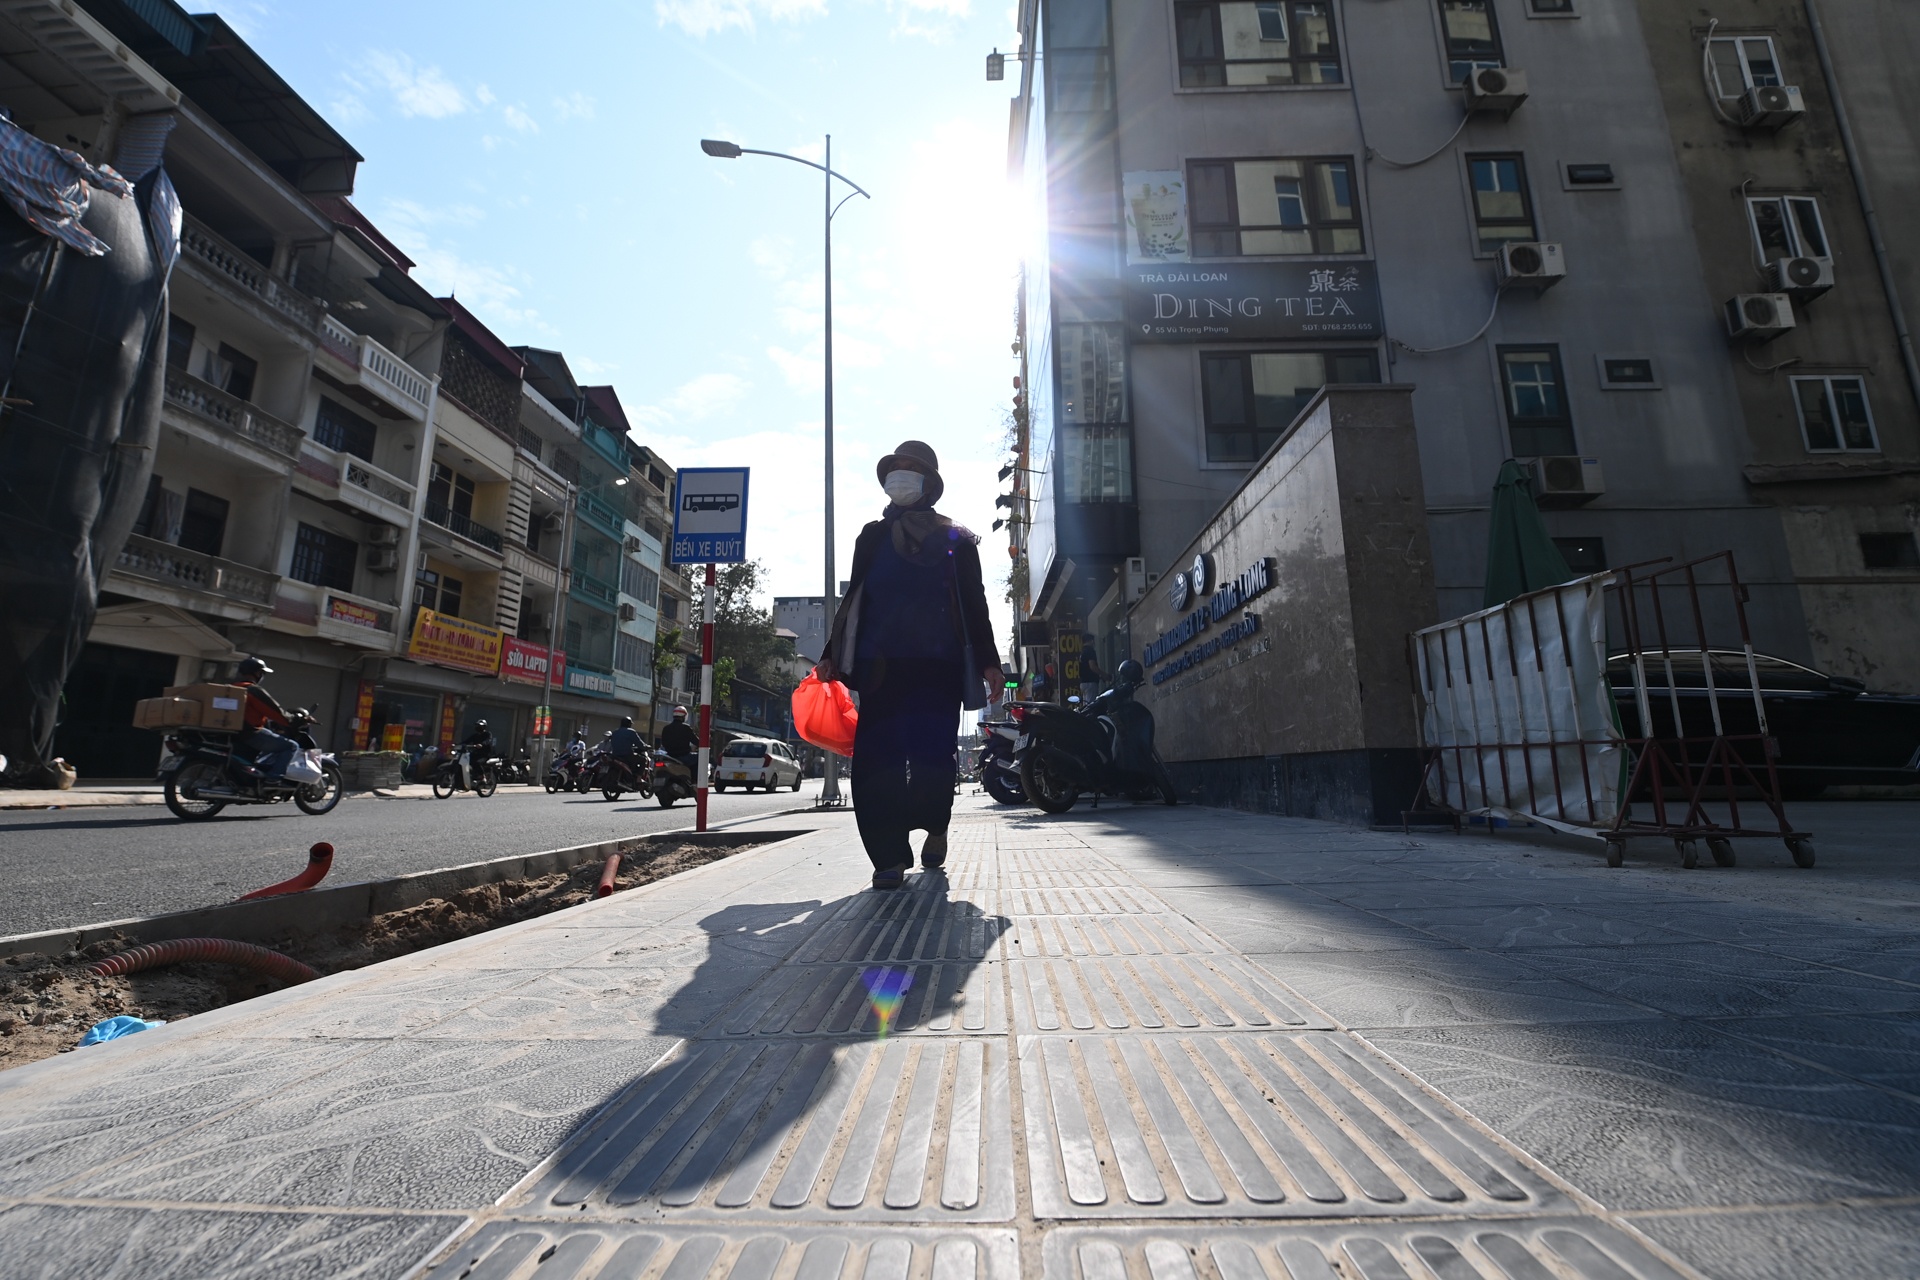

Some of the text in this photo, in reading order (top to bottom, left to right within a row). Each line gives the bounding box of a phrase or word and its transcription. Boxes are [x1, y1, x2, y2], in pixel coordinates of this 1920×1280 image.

[1138, 271, 1228, 283] TRÀ ĐÀI LOAN
[1152, 293, 1356, 319] DING TEA
[1179, 326, 1202, 334] Trọng
[1203, 325, 1229, 334] Phụng
[674, 536, 742, 557] BẾN XE BUÝT
[1194, 606, 1206, 633] 12
[1238, 557, 1268, 603] LONG
[507, 648, 524, 668] SỬA
[525, 654, 548, 673] LAPTO
